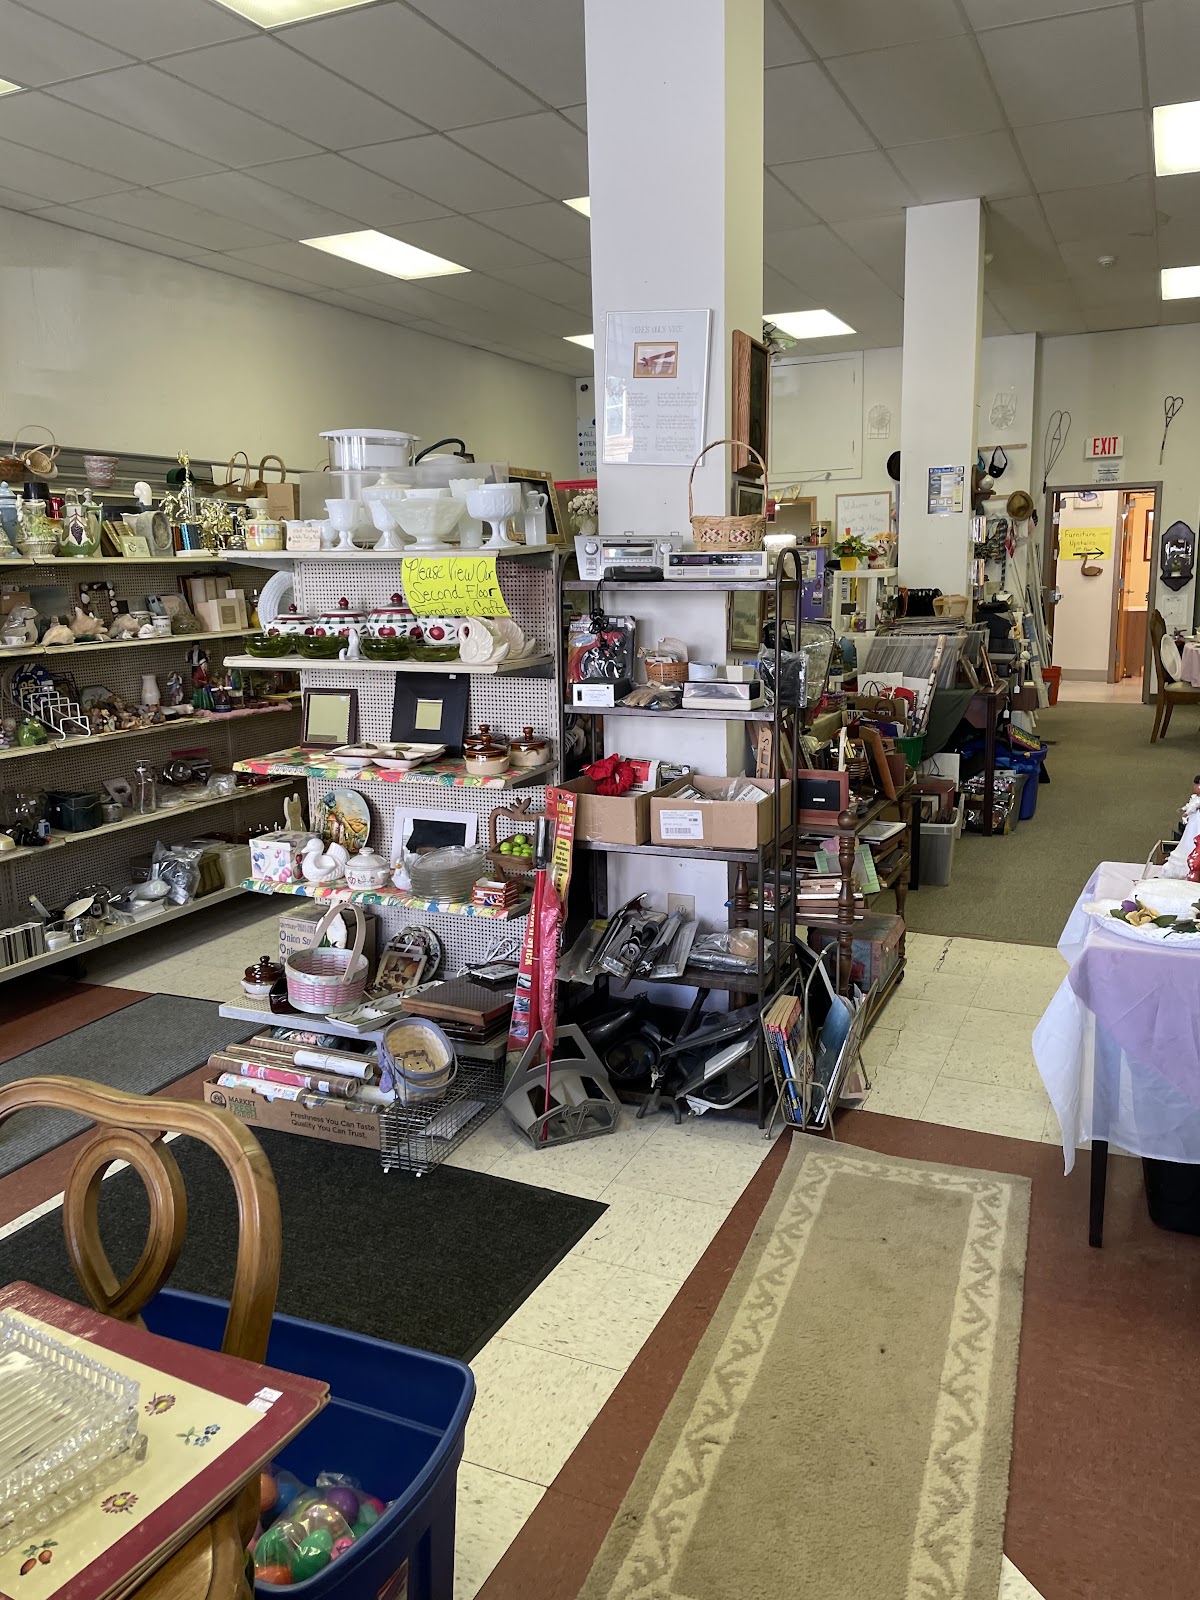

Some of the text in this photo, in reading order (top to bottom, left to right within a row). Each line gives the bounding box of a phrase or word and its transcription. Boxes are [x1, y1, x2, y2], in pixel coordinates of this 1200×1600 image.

[1092, 436, 1119, 456] EXIT
[1065, 530, 1096, 538] Furniture
[405, 558, 445, 582] Please
[449, 558, 474, 582] View
[410, 582, 498, 603] Second Floor
[474, 600, 507, 616] Crafts
[279, 930, 301, 944] Onion
[228, 1095, 256, 1107] MARKET
[229, 1101, 257, 1115] FRESH
[290, 1111, 378, 1132] Freshness You Can Taste.
[291, 1119, 367, 1139] Quality You Can Trust.
